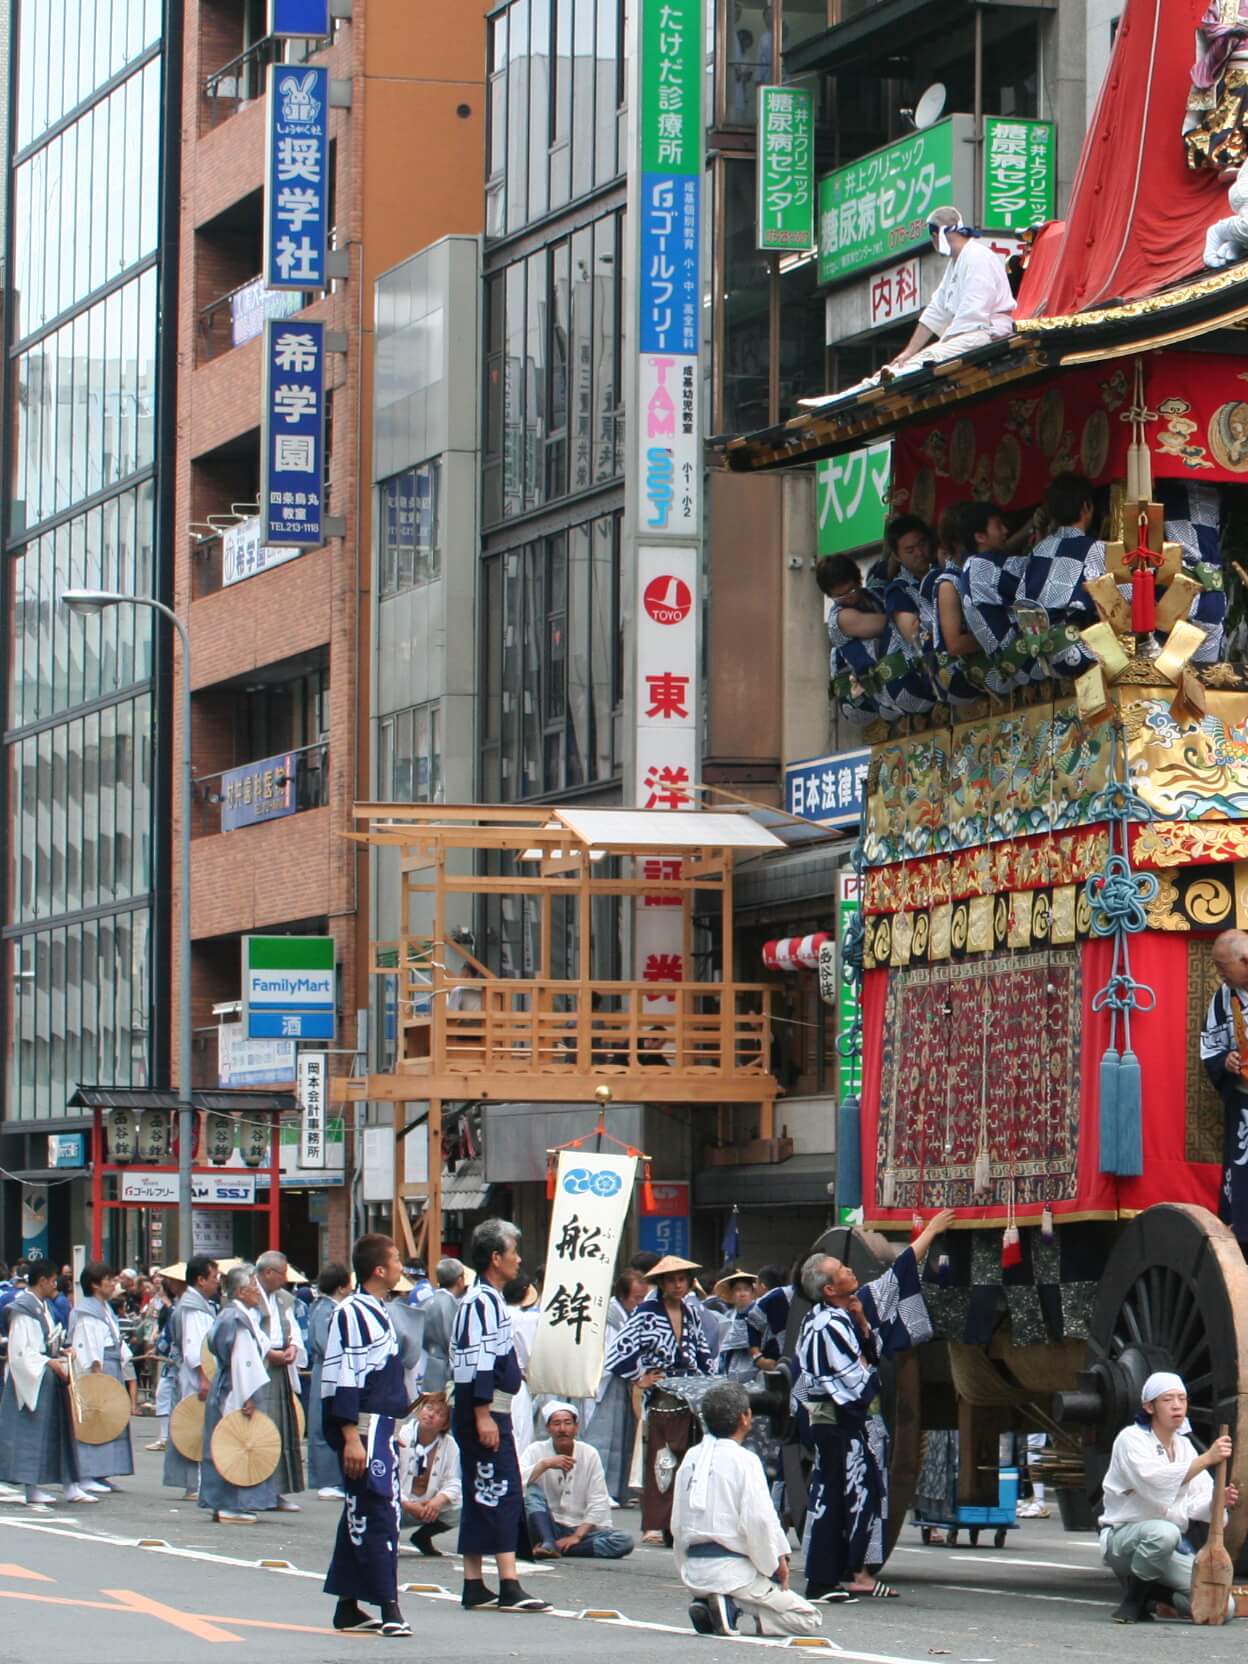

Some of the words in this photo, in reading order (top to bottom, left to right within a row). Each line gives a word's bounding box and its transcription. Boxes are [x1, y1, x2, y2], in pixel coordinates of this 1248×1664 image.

[657, 5, 684, 165] たけだ診療所
[766, 93, 794, 229] 糖尿病センター
[793, 109, 809, 206] 井上クリニック
[844, 137, 925, 198] 井上クリニック
[990, 124, 1029, 227] 糖尿病センター
[1029, 143, 1048, 226] 井上クリニック
[275, 137, 321, 280] 奨学社
[821, 162, 952, 257] 糖尿病センター
[872, 263, 918, 323] 内科
[273, 333, 318, 474] 希学園
[646, 447, 673, 529] SSJ
[651, 608, 683, 622] TOYO
[252, 977, 330, 996] FamilyMart
[281, 1015, 302, 1036] 酒
[307, 1061, 320, 1160] 岡本会計事務所
[216, 1188, 252, 1199] SSJ
[545, 1213, 603, 1345] 船鉾
